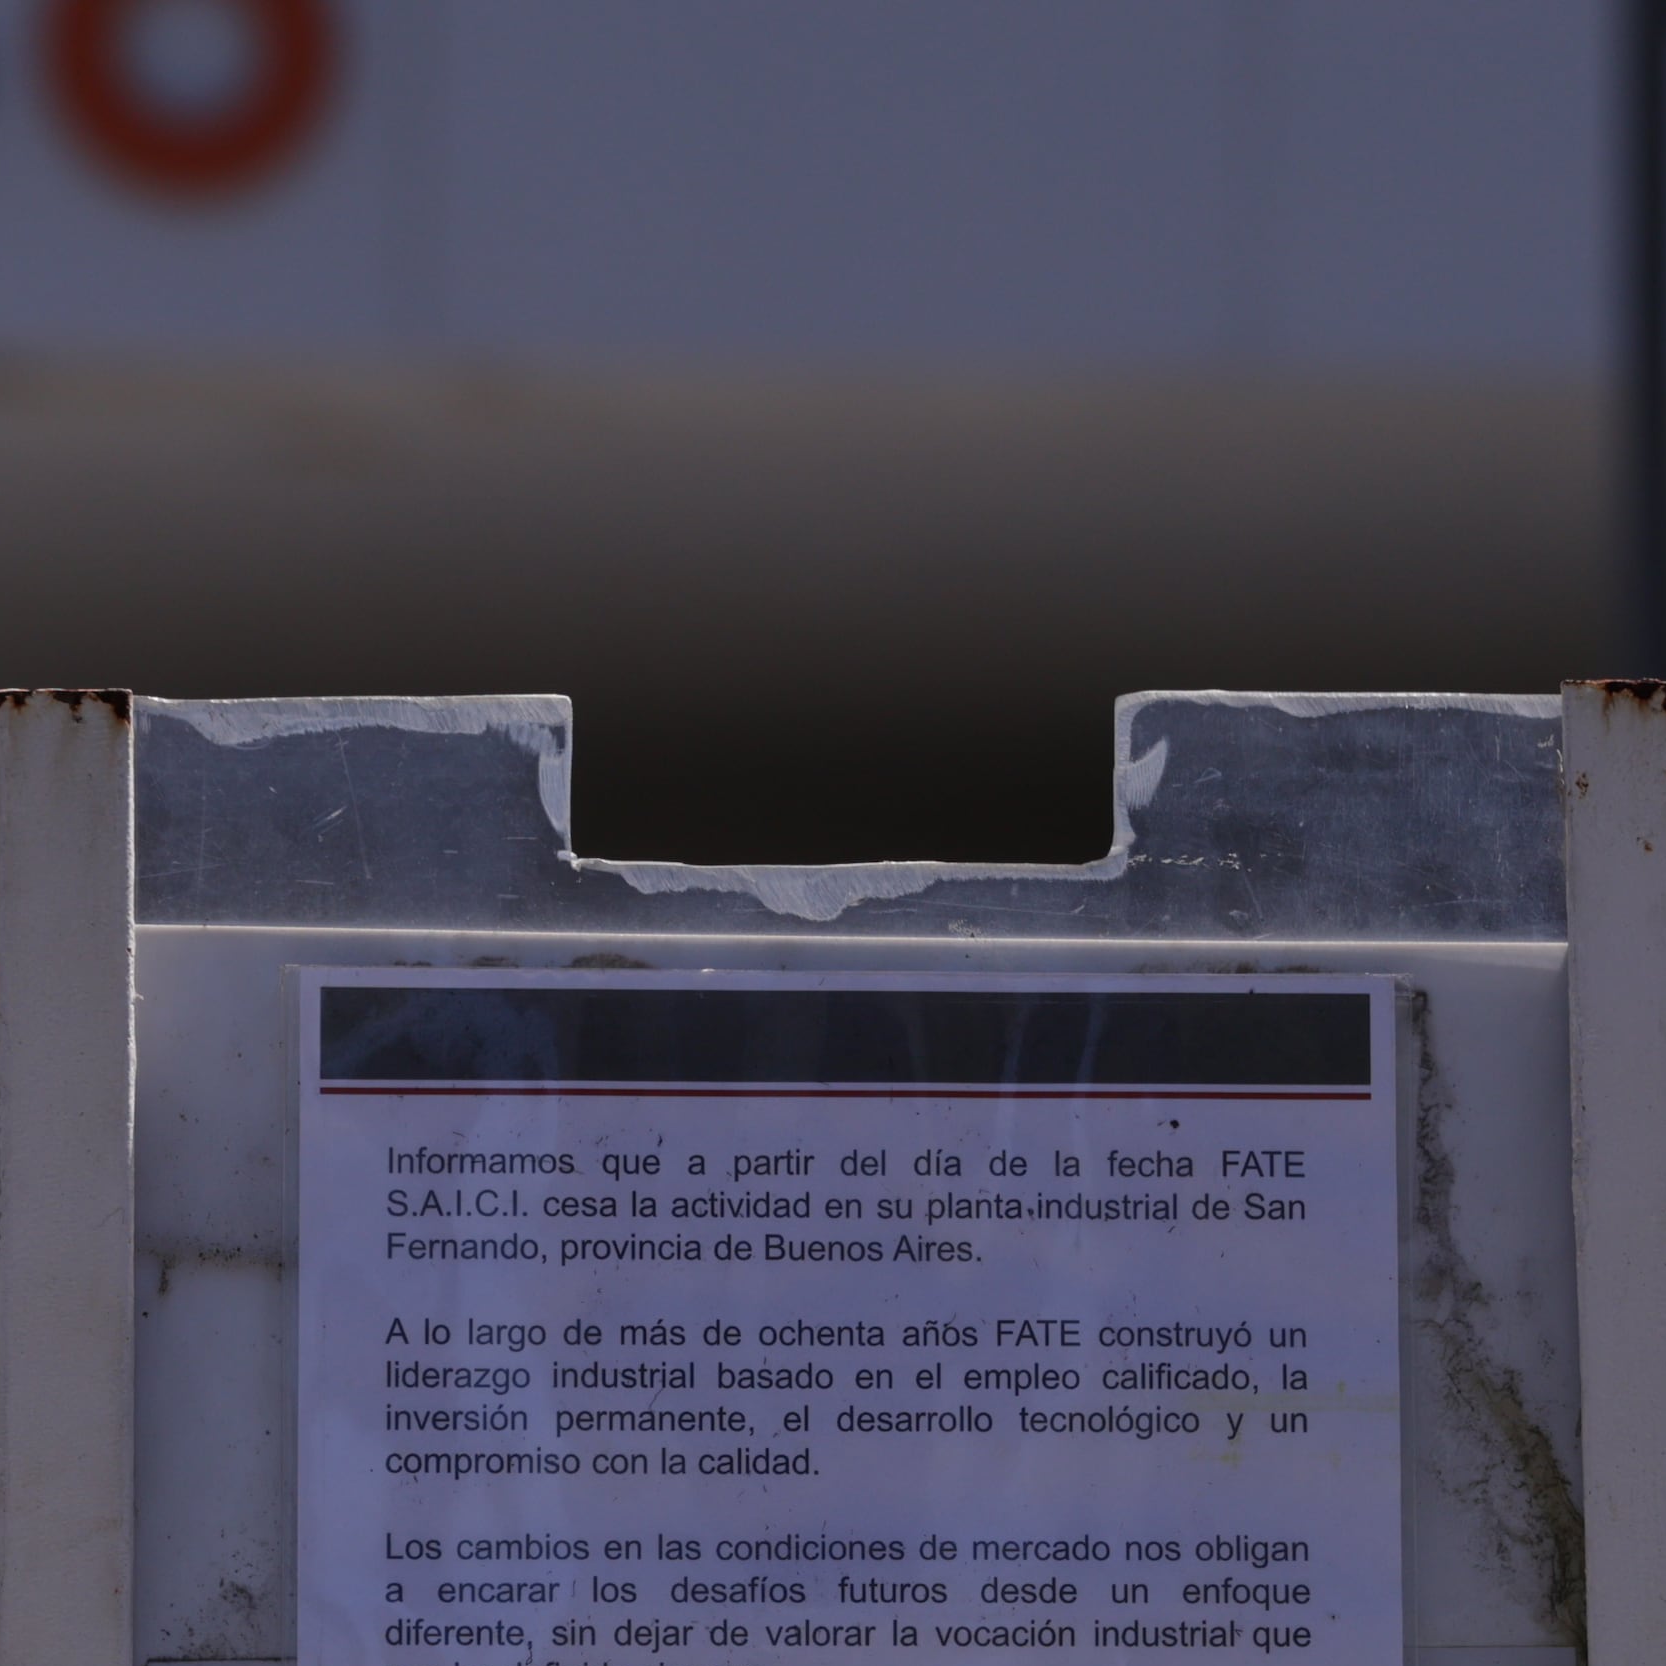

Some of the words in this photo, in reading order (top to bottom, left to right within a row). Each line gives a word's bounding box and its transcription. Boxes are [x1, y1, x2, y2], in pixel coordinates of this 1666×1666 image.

[388, 1147, 576, 1175] Informamos
[601, 1154, 662, 1182] que
[687, 1154, 706, 1176] a
[732, 1147, 816, 1183] partir
[839, 1148, 886, 1177] del
[913, 1148, 962, 1177] día
[988, 1149, 1028, 1177] de
[1054, 1149, 1081, 1178] la
[1106, 1149, 1194, 1178] fecha
[1221, 1149, 1306, 1179] FATE
[386, 1188, 529, 1218] S.A.I.C.I.
[542, 1195, 618, 1218] cesa
[631, 1189, 658, 1219] la
[670, 1190, 811, 1219] actividad
[824, 1197, 862, 1220] en
[876, 1198, 913, 1220] su
[924, 1191, 1026, 1225] planta
[1036, 1191, 1178, 1221] industrial
[1191, 1192, 1231, 1221] de
[1243, 1191, 1306, 1221] San
[386, 1231, 548, 1265] Fernando,
[560, 1232, 702, 1267] provincia
[713, 1233, 753, 1262] de
[764, 1233, 884, 1263] Buenos
[892, 1234, 982, 1263] Aires.
[384, 1316, 410, 1345] A
[424, 1317, 452, 1346] lo
[468, 1317, 547, 1353] largo
[562, 1317, 603, 1347] de
[620, 1318, 686, 1347] más
[702, 1318, 742, 1347] de
[758, 1318, 886, 1347] ochenta
[901, 1319, 979, 1348] años
[996, 1319, 1082, 1347] FATE
[1098, 1320, 1253, 1355] construyó
[1269, 1327, 1307, 1349] un
[386, 1359, 531, 1396] liderazgo
[552, 1360, 695, 1390] industrial
[717, 1360, 834, 1390] basado
[854, 1368, 894, 1390] en
[915, 1361, 942, 1390] el
[963, 1362, 1081, 1397] empleo
[1101, 1361, 1259, 1395] calificado,
[1282, 1362, 1308, 1391] la
[386, 1403, 528, 1432] inversión
[556, 1405, 755, 1438] permanente,
[783, 1404, 810, 1433] el
[836, 1404, 994, 1433] desarrollo
[1018, 1404, 1200, 1441] tecnológico
[1226, 1412, 1244, 1441] y
[1270, 1412, 1308, 1434] un
[384, 1446, 581, 1483] compromiso
[591, 1453, 648, 1476] con
[661, 1447, 687, 1476] la
[697, 1447, 820, 1476] calidad.
[385, 1531, 443, 1561] Los
[456, 1532, 590, 1561] cambios
[603, 1539, 642, 1561] en
[657, 1532, 702, 1561] las
[715, 1533, 906, 1562] condiciones
[918, 1533, 958, 1561] de
[972, 1533, 1111, 1562] mercado
[1125, 1540, 1182, 1562] nos
[1194, 1534, 1309, 1569] obligan
[384, 1582, 404, 1604] a
[437, 1582, 560, 1604] encarar
[592, 1575, 638, 1604] los
[670, 1575, 807, 1604] desafíos
[837, 1575, 948, 1604] futuros
[980, 1576, 1078, 1605] desde
[1111, 1583, 1149, 1605] un
[1182, 1576, 1311, 1612] enfoque
[384, 1617, 533, 1652] diferente,
[551, 1618, 596, 1647] sin
[613, 1618, 694, 1654] dejar
[708, 1618, 749, 1647] de
[764, 1618, 877, 1647] valorar
[892, 1618, 918, 1648] la
[934, 1618, 1076, 1648] vocación
[1094, 1619, 1237, 1648] industrial
[1251, 1626, 1312, 1655] que
